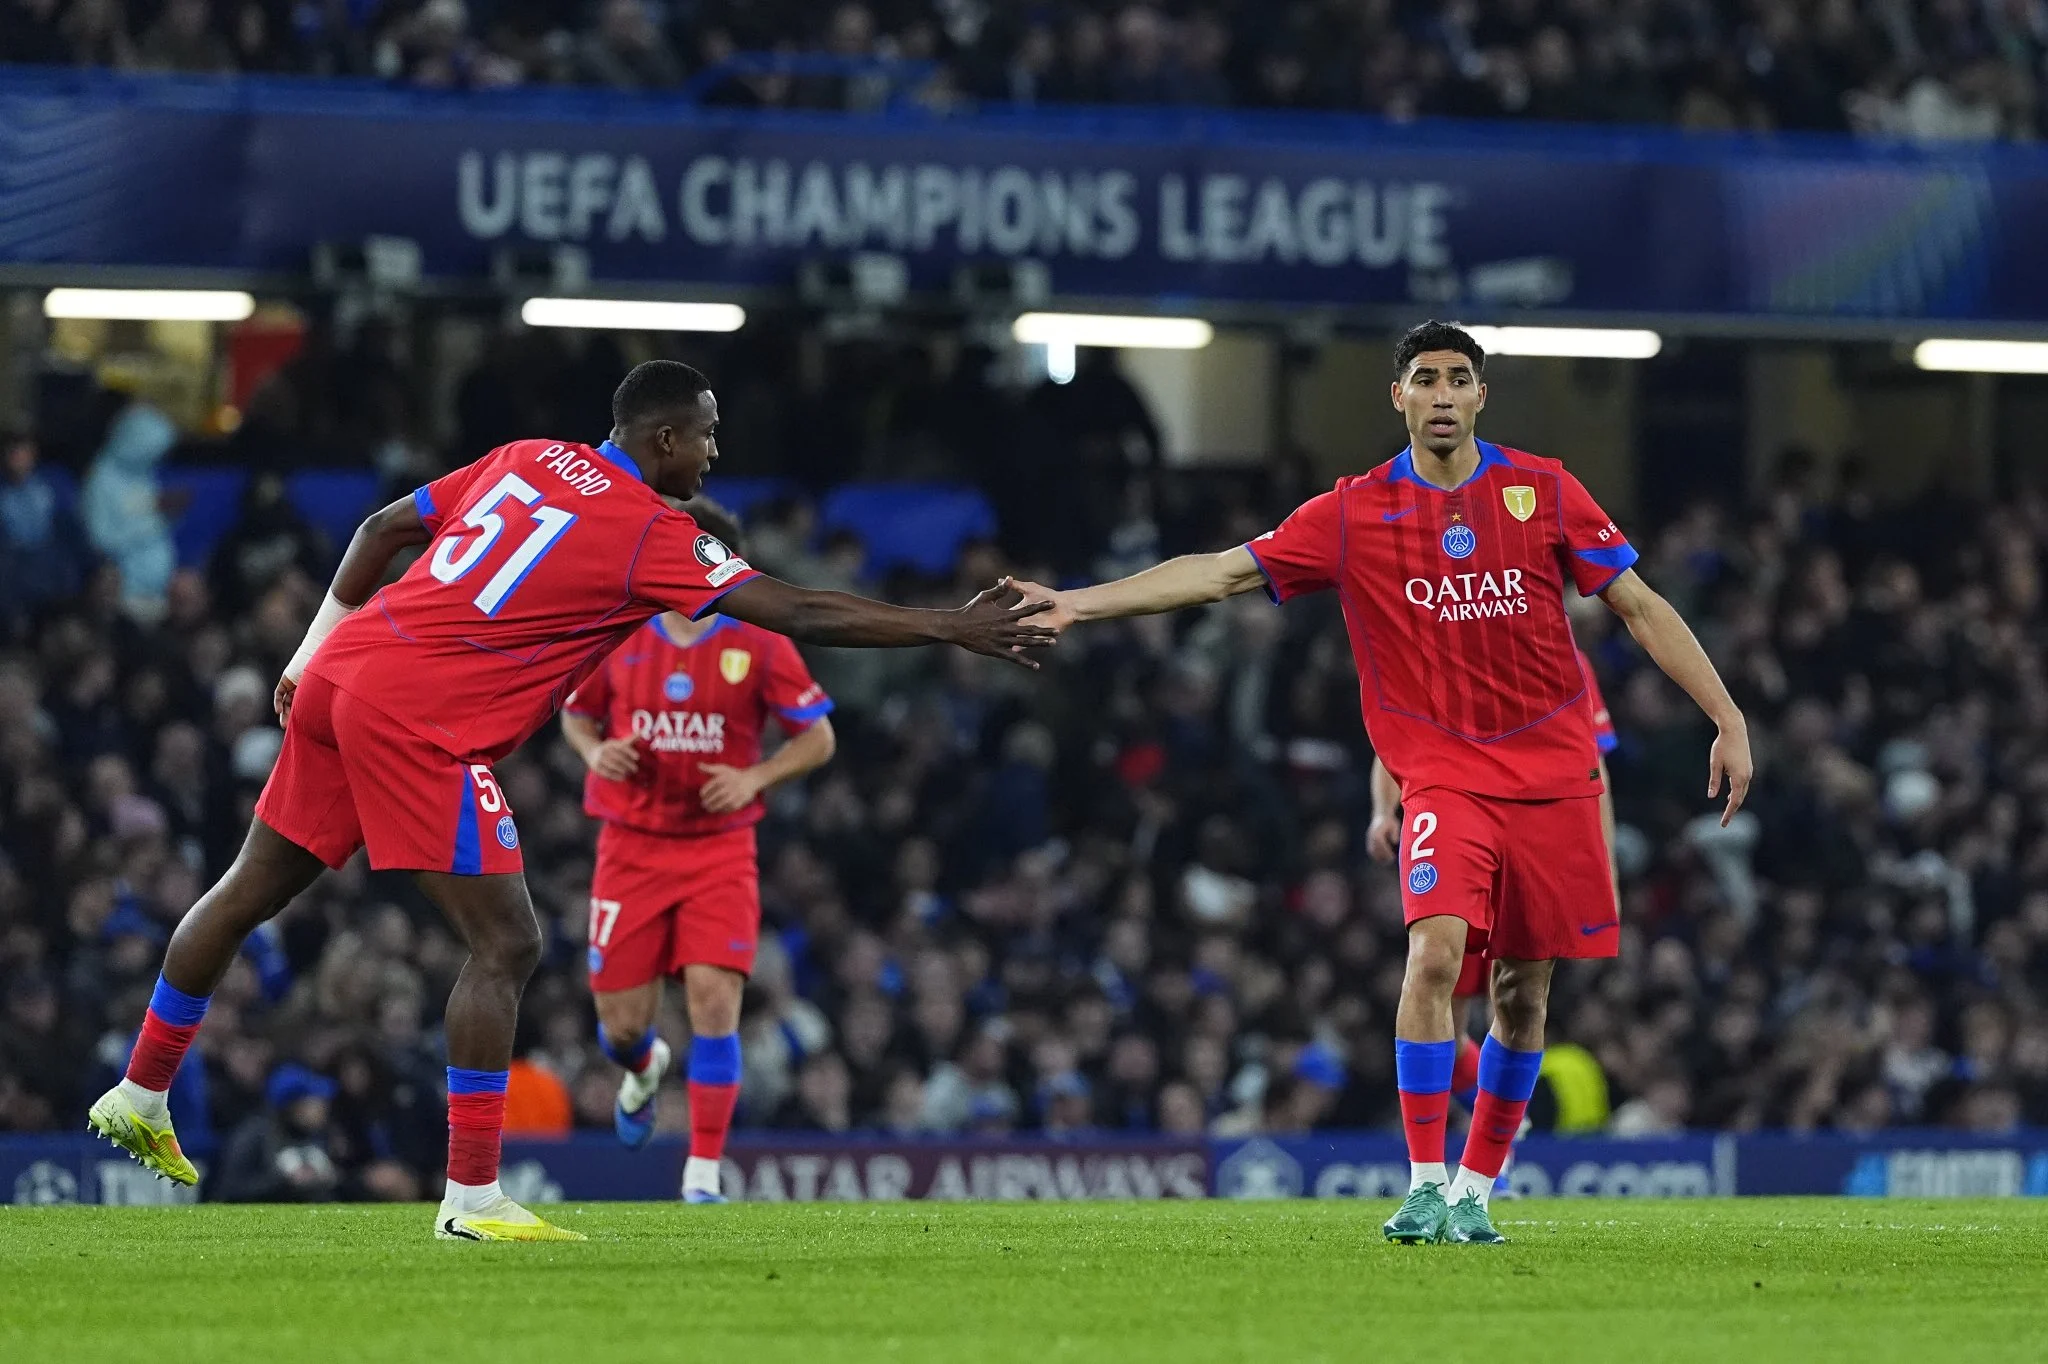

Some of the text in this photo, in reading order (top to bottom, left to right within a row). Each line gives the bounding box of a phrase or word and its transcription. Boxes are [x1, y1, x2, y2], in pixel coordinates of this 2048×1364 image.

[458, 152, 1452, 269] UEFA CHAMPIONS LEAGUE
[535, 444, 612, 496] PACHO
[430, 471, 579, 619] 51
[1447, 527, 1469, 537] PARIS
[1405, 568, 1525, 611] QATAR
[1438, 596, 1528, 623] AIRWAYS
[632, 709, 725, 741] QATAR
[470, 765, 513, 813] 5
[1411, 812, 1437, 860] 2
[1412, 864, 1431, 875] PARIS
[926, 1152, 1208, 1201] AIRWAYS
